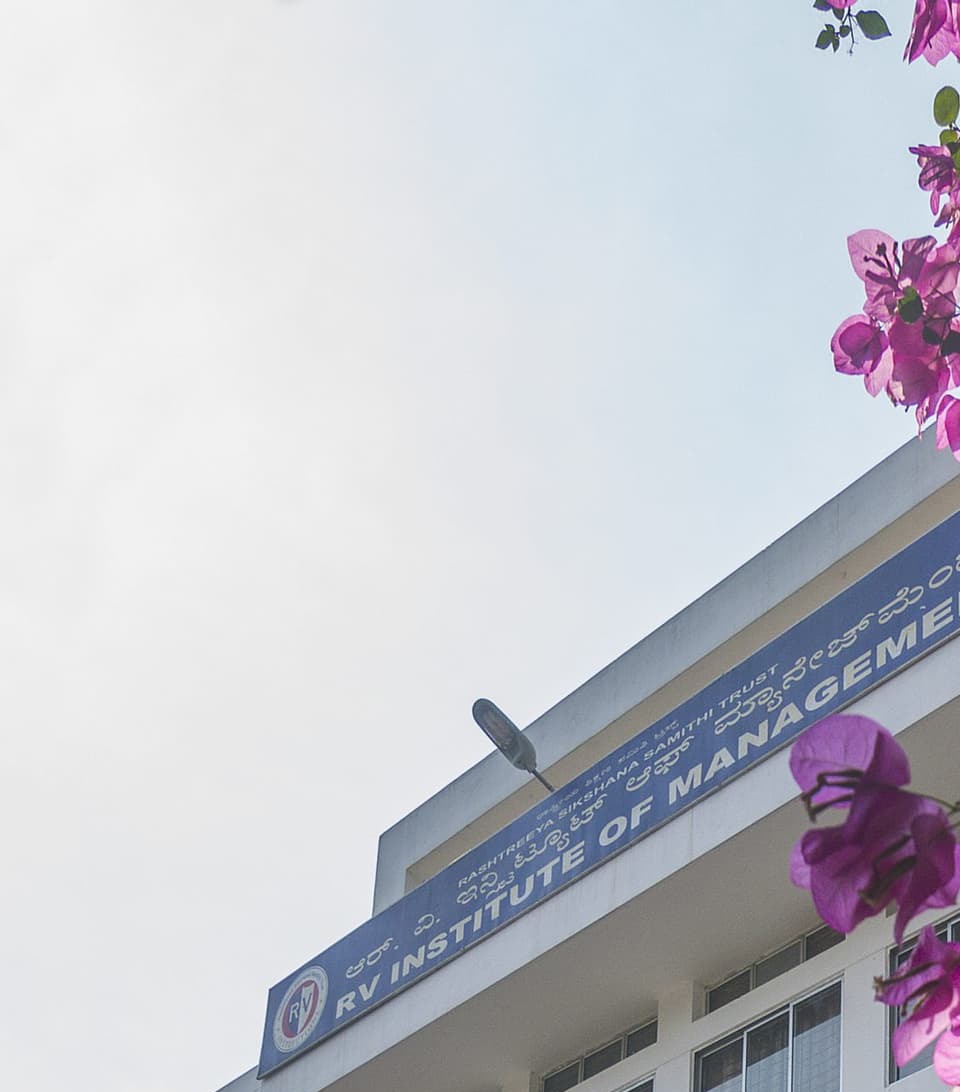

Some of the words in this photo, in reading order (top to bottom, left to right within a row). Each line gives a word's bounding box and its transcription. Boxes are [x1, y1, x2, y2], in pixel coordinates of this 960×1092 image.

[458, 818, 554, 888] RASHTREEYA
[558, 760, 640, 819] SIKSHANA
[644, 707, 714, 761] SAMITHI
[718, 662, 779, 710] TRUST
[335, 970, 381, 1020] RV
[390, 840, 586, 986] INSTITUTE
[597, 795, 654, 847] OF
